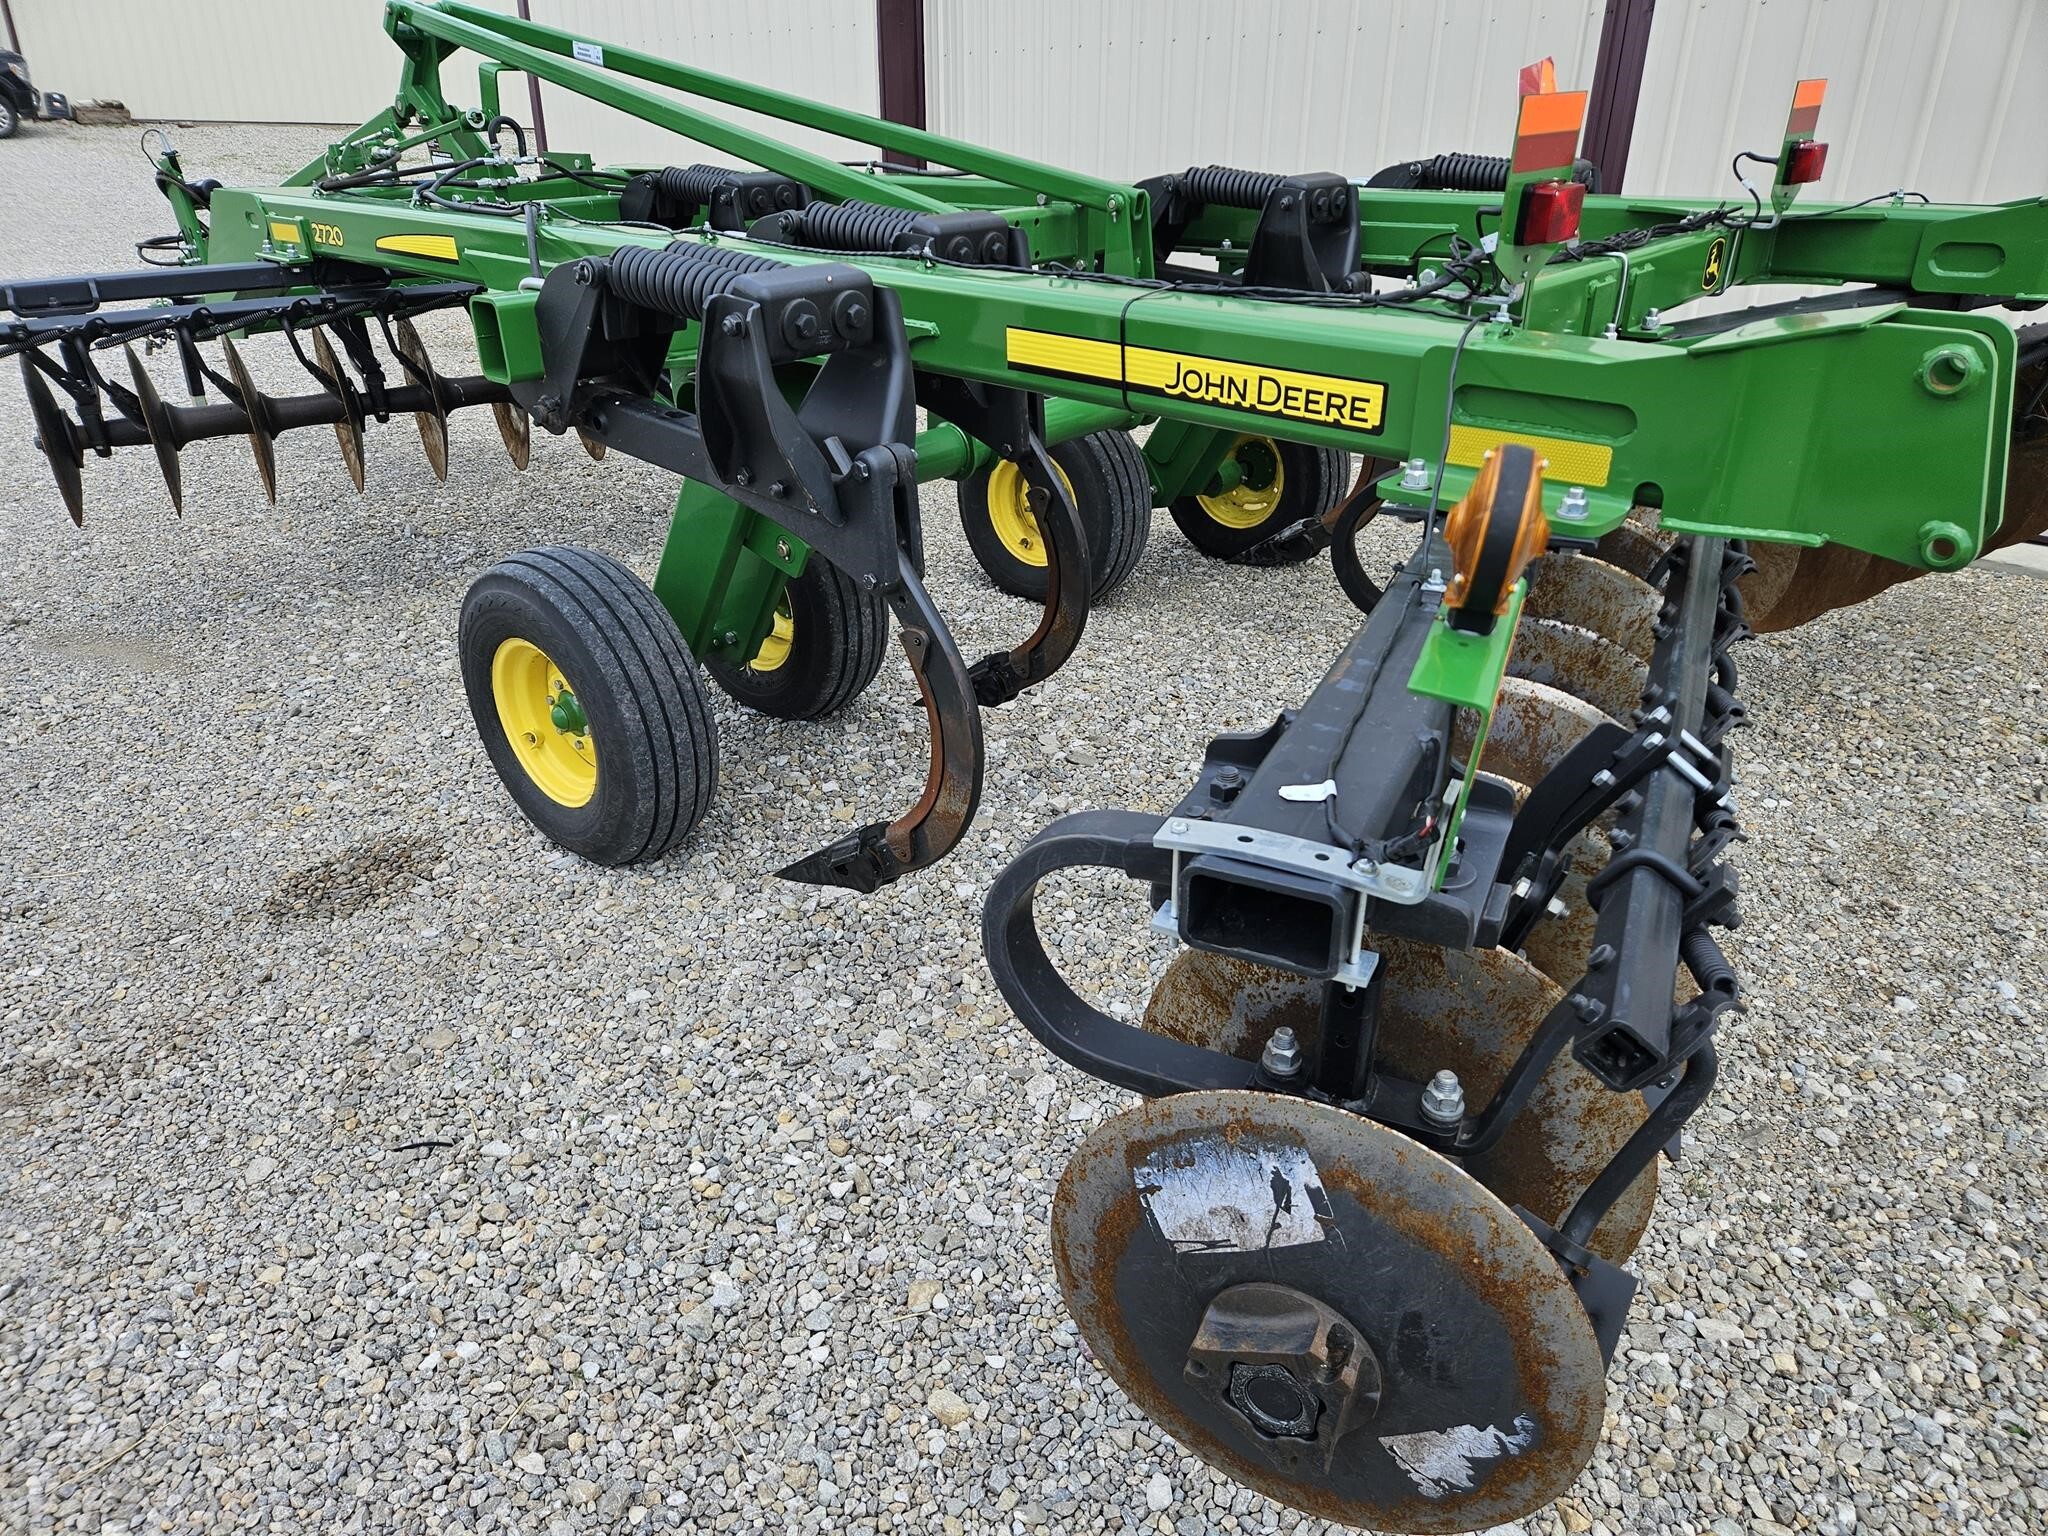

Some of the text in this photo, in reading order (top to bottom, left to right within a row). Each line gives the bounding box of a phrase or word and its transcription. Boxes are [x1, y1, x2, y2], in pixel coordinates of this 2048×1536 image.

[311, 222, 344, 247] 2720
[1165, 362, 1371, 424] JOHN DEERE
